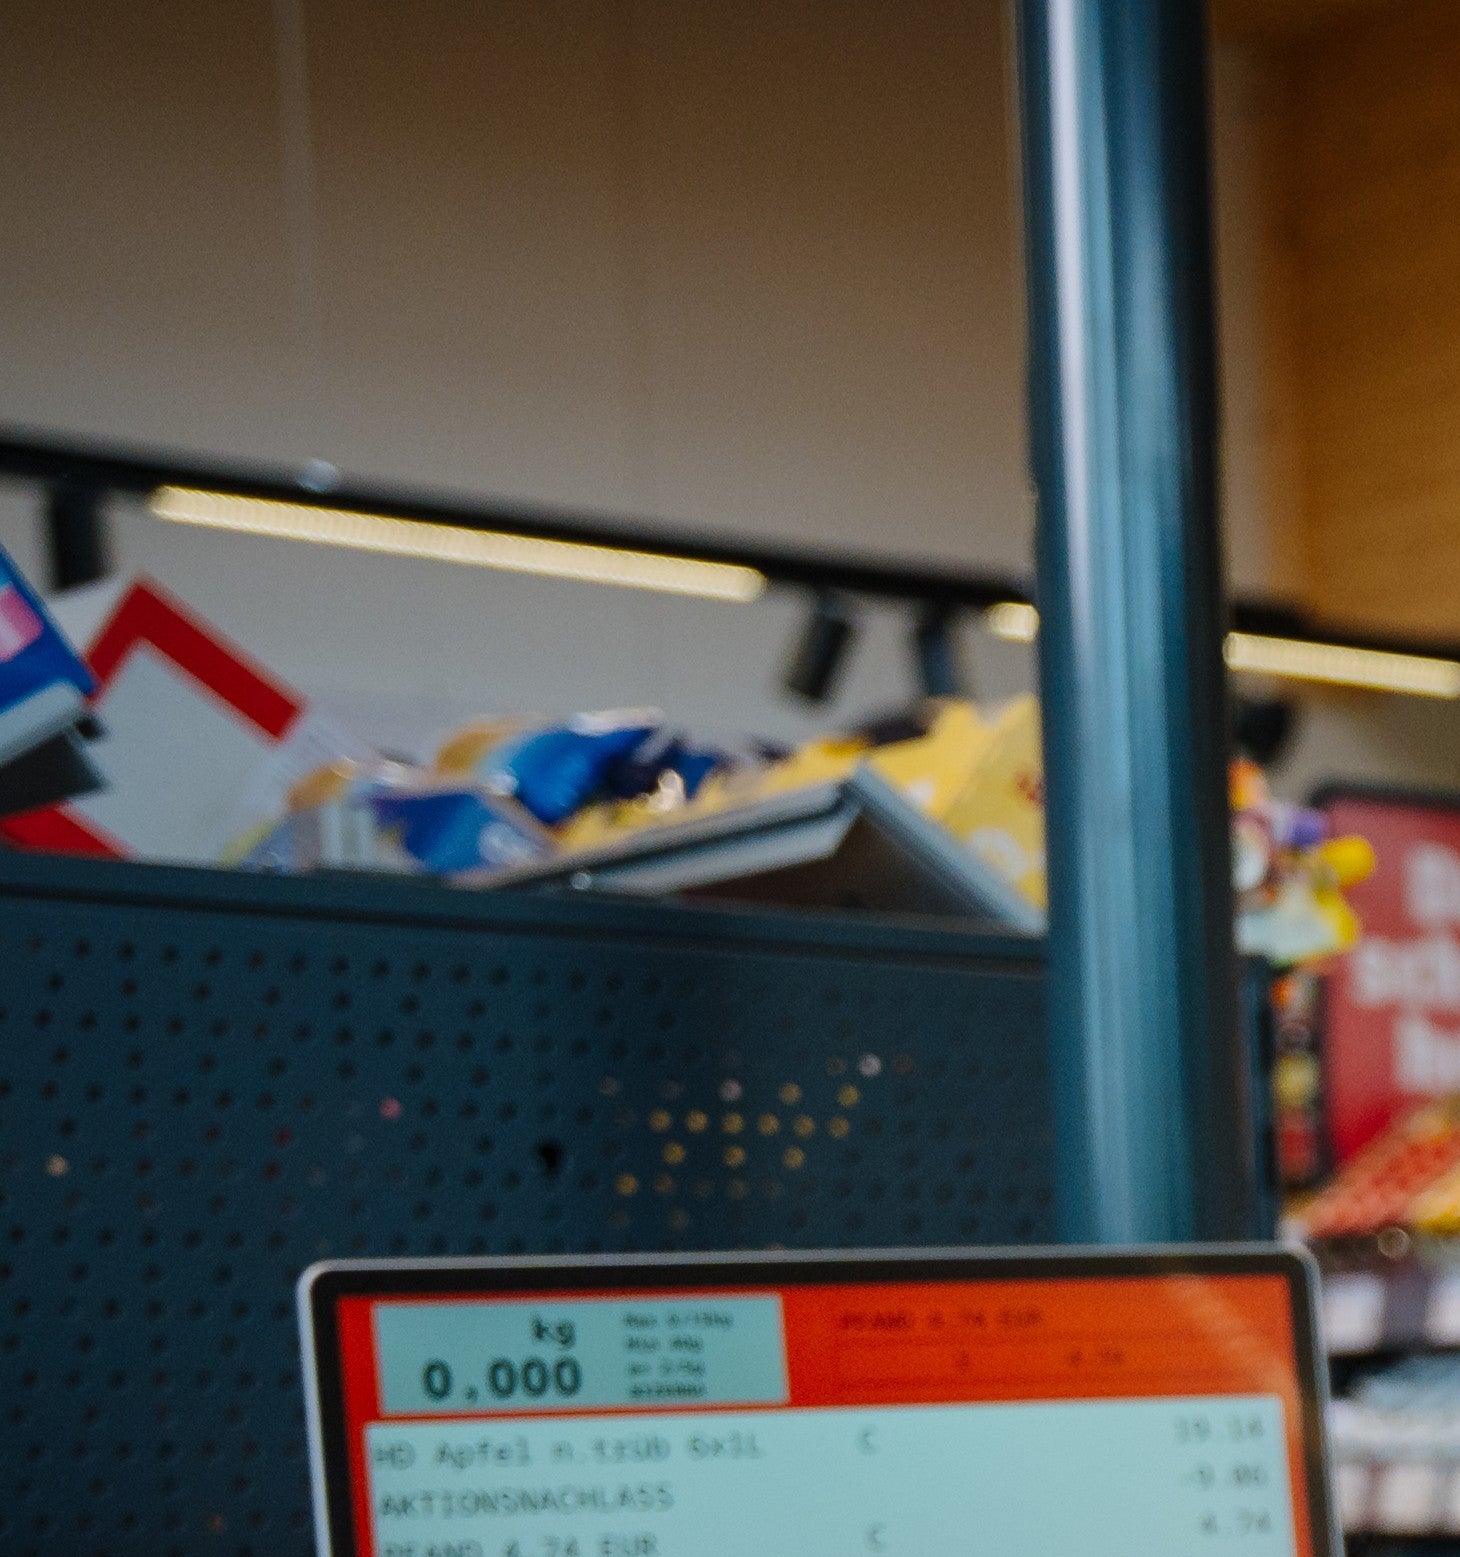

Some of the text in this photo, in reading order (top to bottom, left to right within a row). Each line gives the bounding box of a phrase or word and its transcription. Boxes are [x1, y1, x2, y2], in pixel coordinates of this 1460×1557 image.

[532, 1313, 575, 1349] kg
[422, 1355, 582, 1402] 0,000
[434, 1435, 531, 1472] Apfel
[379, 1481, 677, 1519] AKTIONSNACHLASS
